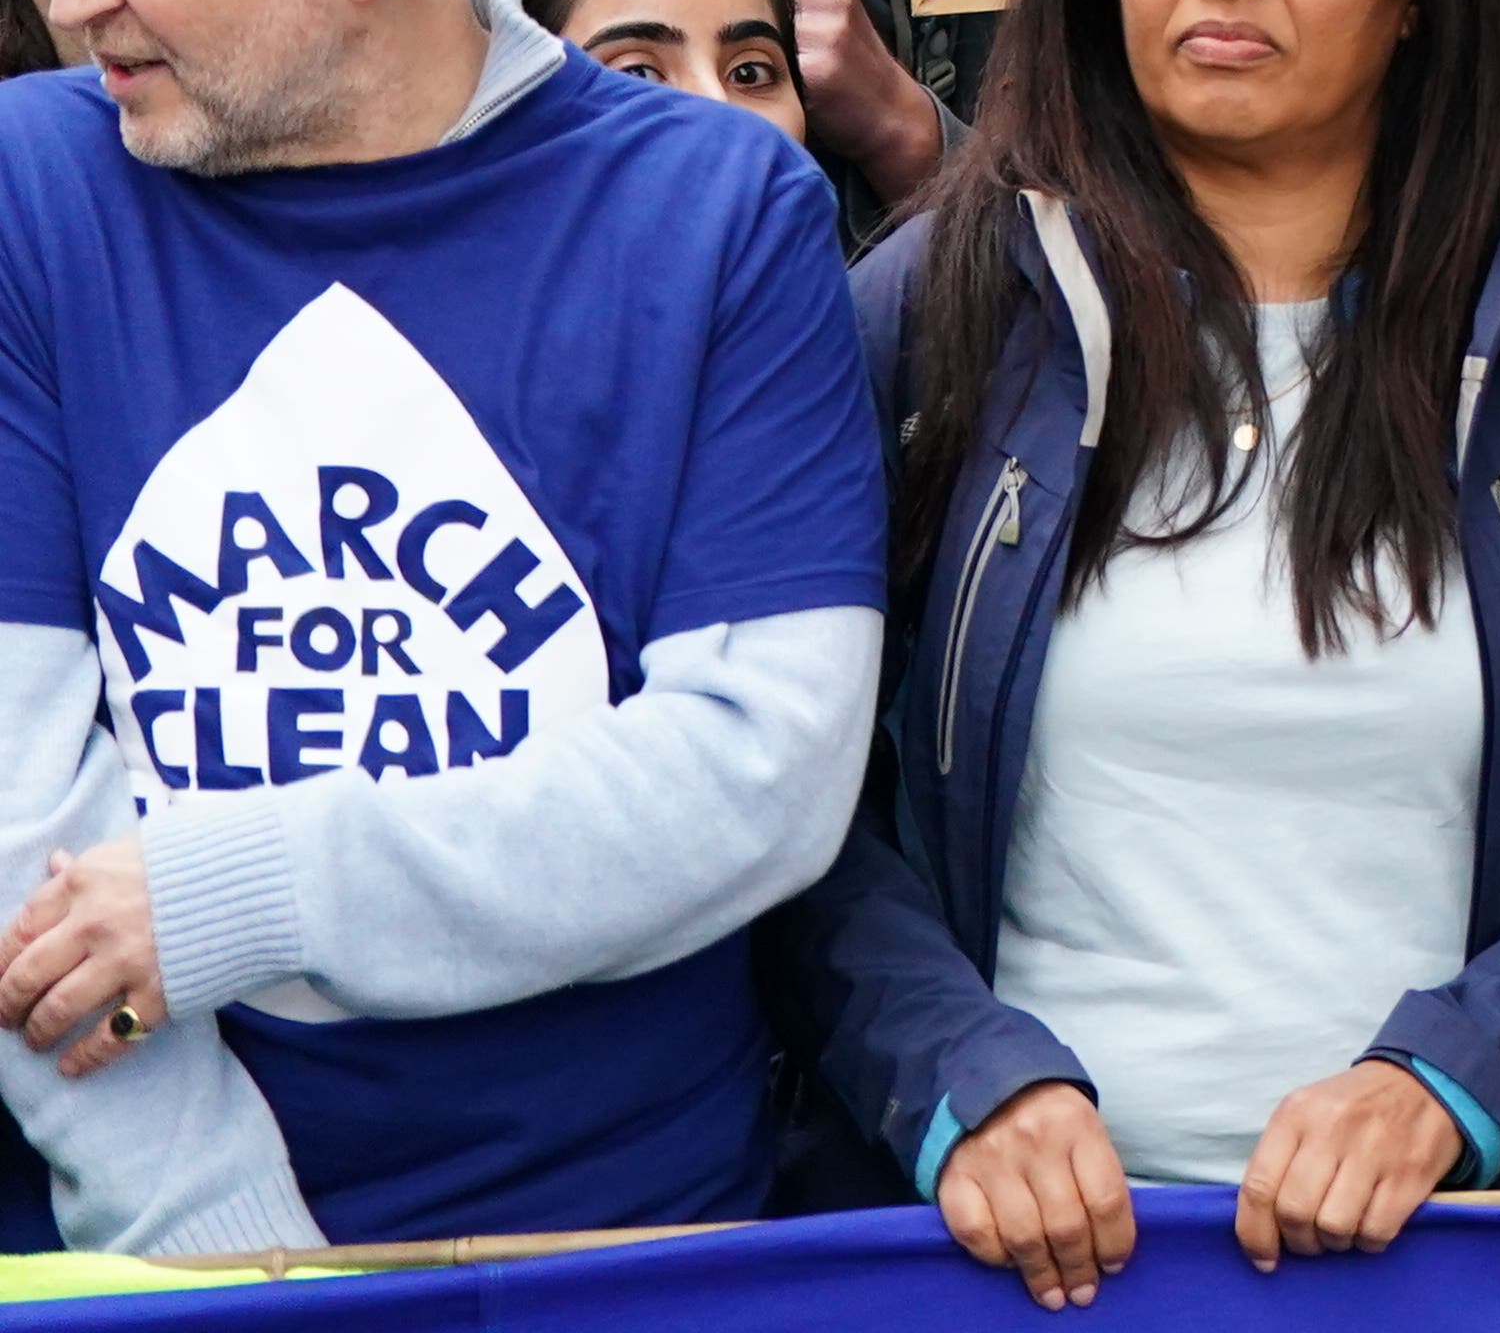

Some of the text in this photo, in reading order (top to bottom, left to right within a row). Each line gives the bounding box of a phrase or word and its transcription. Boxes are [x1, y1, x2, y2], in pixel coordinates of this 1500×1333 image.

[96, 465, 586, 683] MARCH
[236, 605, 422, 677] FOR
[130, 687, 530, 791] CLEAN
